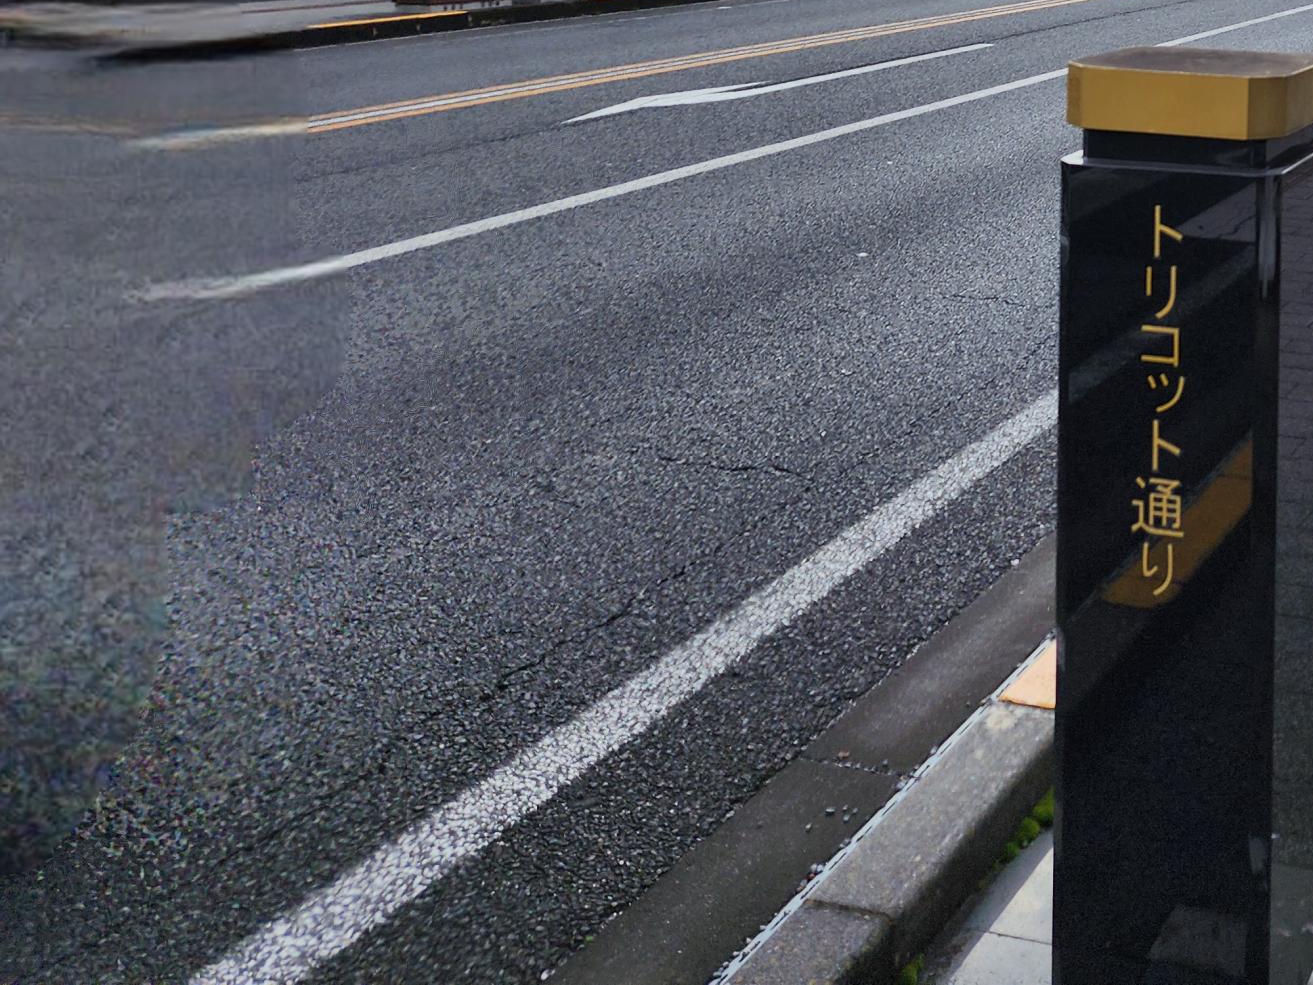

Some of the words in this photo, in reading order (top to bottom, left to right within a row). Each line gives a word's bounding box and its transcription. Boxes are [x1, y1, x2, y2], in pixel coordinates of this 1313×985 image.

[1130, 204, 1187, 596] トリコット通り
